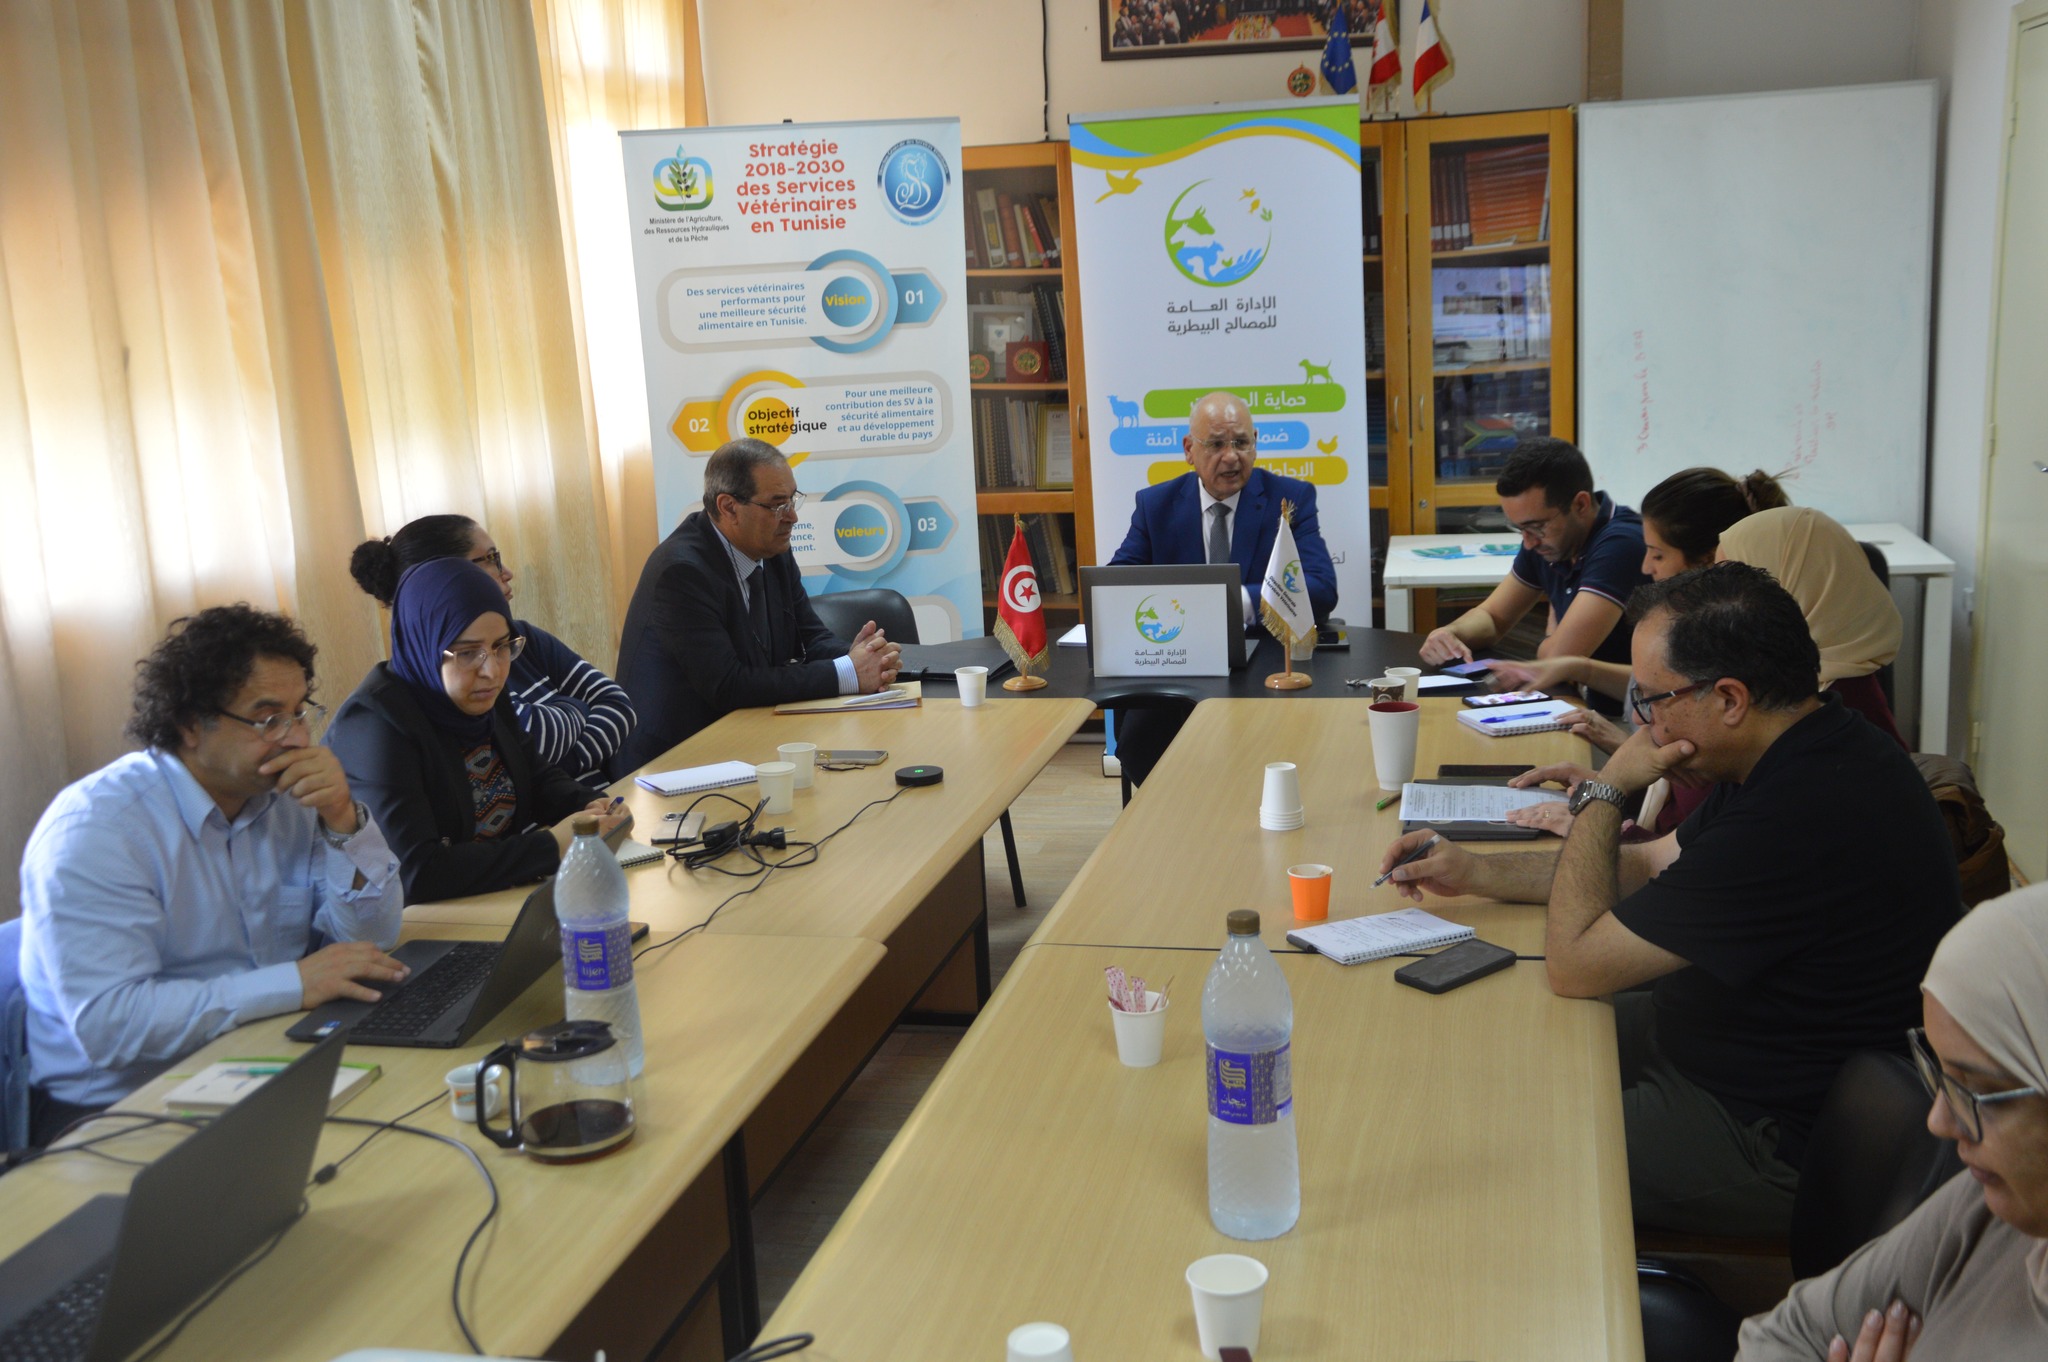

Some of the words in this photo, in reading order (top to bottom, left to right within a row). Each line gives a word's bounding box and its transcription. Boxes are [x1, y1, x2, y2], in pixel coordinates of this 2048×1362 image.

[749, 139, 838, 159] Stratégie
[745, 159, 845, 177] 2018-2030
[736, 181, 771, 196] des
[776, 177, 856, 194] Services
[737, 195, 857, 215] Vétérinaires
[649, 217, 676, 225] Ministère
[685, 215, 723, 224] l'Agriculture,
[751, 221, 774, 233] en
[780, 214, 846, 232] Tunisie
[656, 226, 690, 234] Ressources
[691, 225, 730, 234] Hydrauliques
[686, 288, 704, 296] Des
[706, 286, 745, 295] services
[747, 283, 805, 293] vétérinaires
[905, 289, 923, 305] 01
[720, 296, 781, 308] performants
[783, 294, 806, 304] pour
[1236, 295, 1276, 314] الإدارة
[699, 311, 718, 319] une
[720, 308, 766, 318] meilleure
[768, 304, 806, 315] sécurité
[698, 320, 753, 331] alimentaire
[756, 319, 768, 327] en
[770, 317, 807, 327] Tunisie.
[1168, 317, 1220, 336] البيطرية
[1225, 315, 1277, 334] للمصالح
[845, 390, 867, 398] Pour
[869, 389, 887, 397] une
[889, 386, 933, 395] meilleure
[825, 400, 884, 411] contribution
[886, 399, 902, 407] des
[904, 397, 915, 406] SV
[917, 397, 923, 405] à
[925, 396, 934, 404] la
[1264, 390, 1307, 410] حماية
[748, 407, 800, 421] Objectif
[841, 411, 879, 421] sécurité
[881, 408, 934, 419] alimentaire
[689, 418, 710, 433] 02
[749, 420, 828, 435] stratégique
[837, 425, 847, 433] et
[849, 424, 861, 432] au
[863, 419, 935, 431] développement
[860, 432, 896, 442] durable
[898, 431, 910, 440] du
[912, 430, 933, 441] pays
[836, 525, 885, 538] Valeurs
[917, 517, 938, 532] 03
